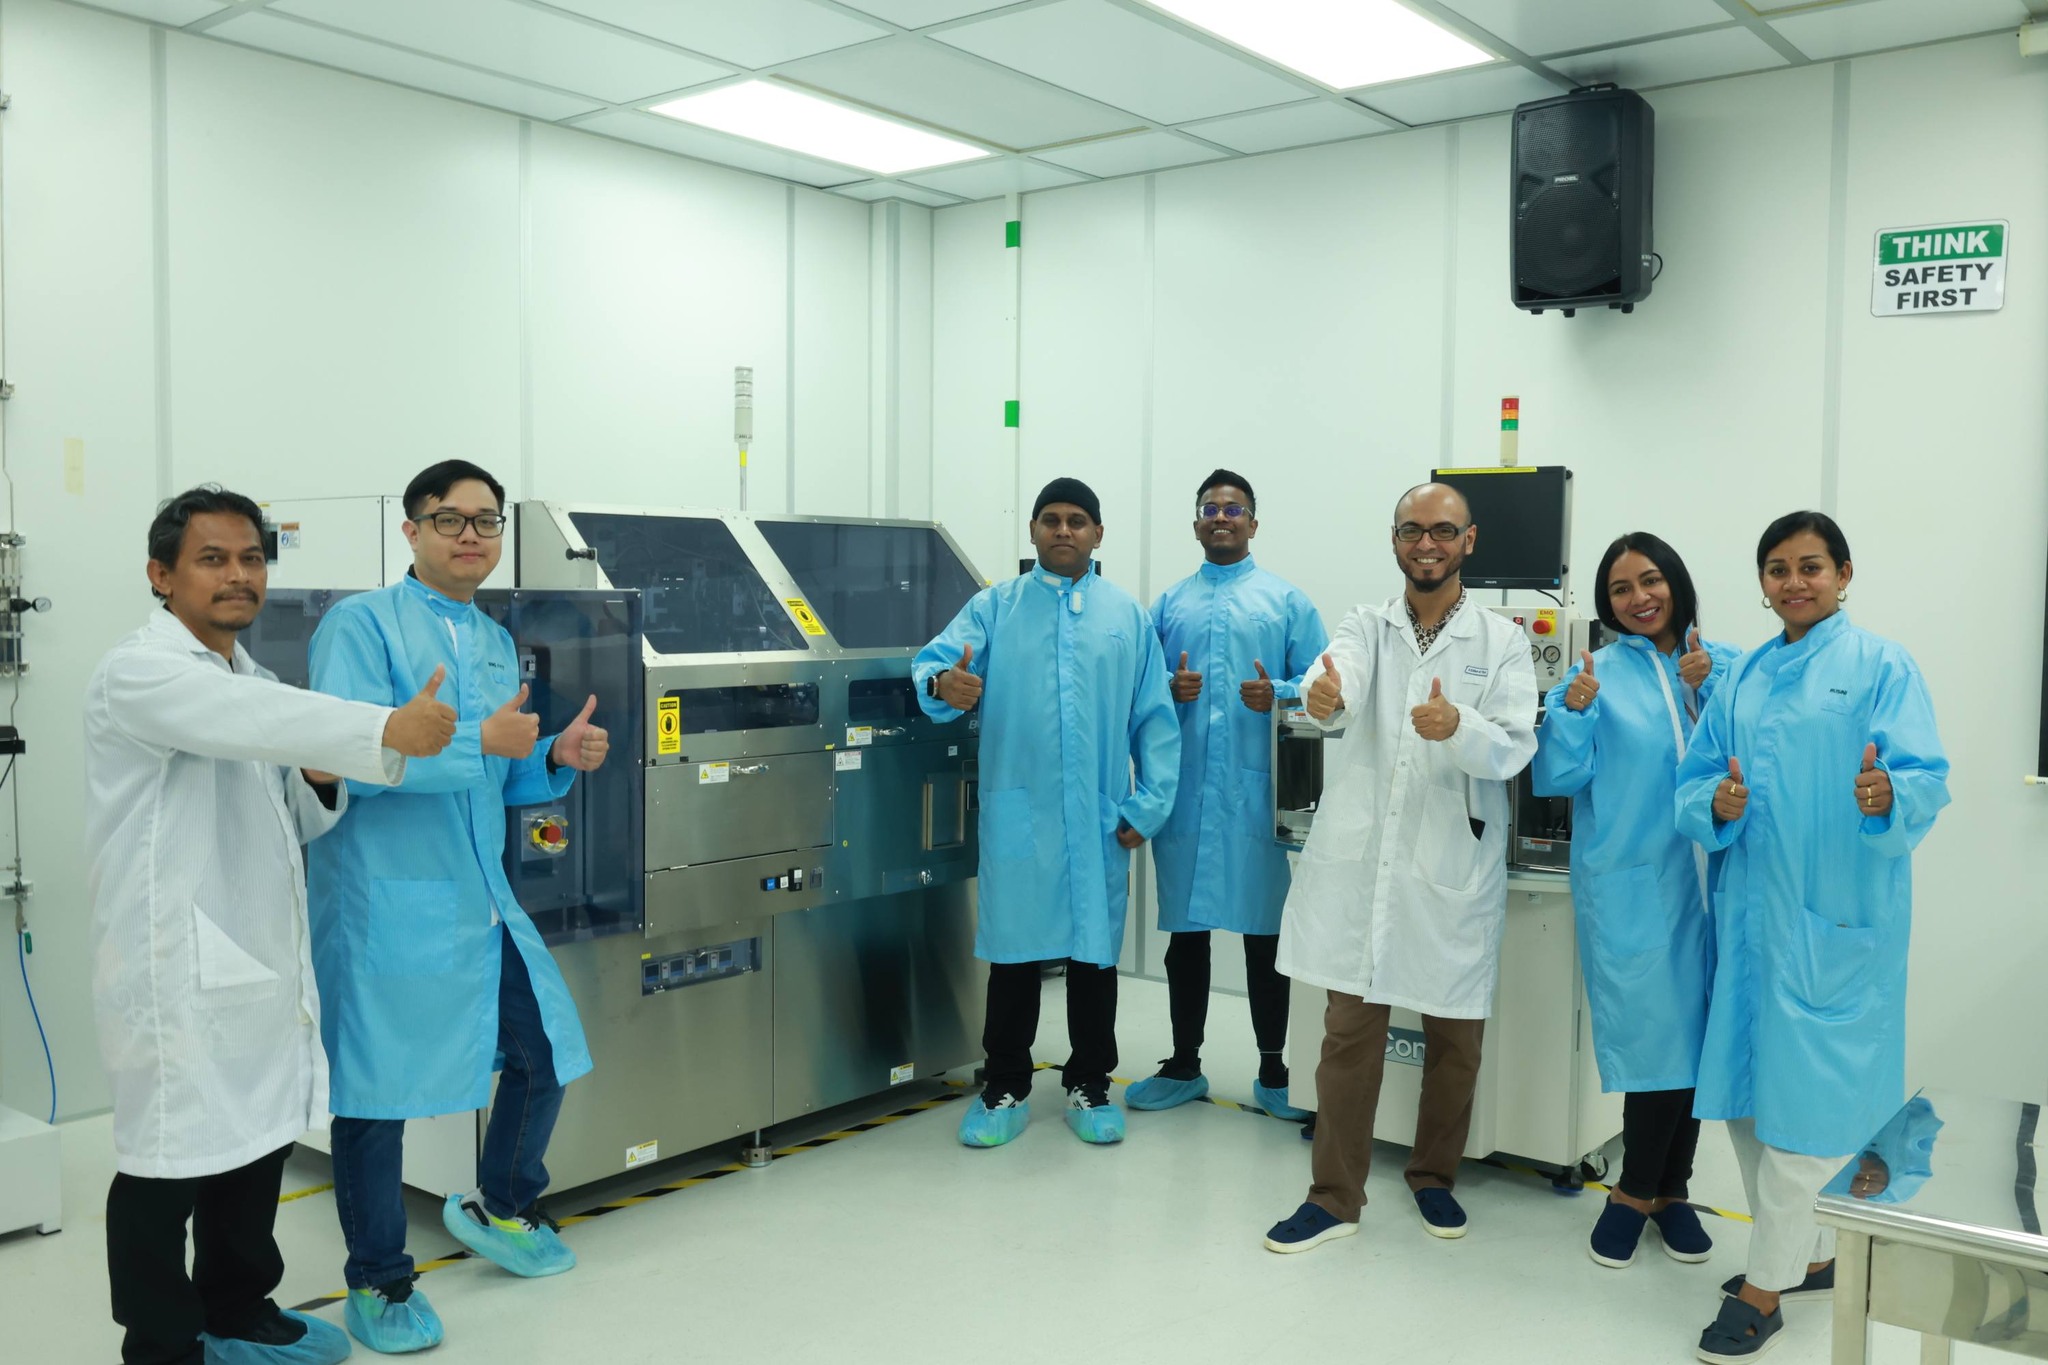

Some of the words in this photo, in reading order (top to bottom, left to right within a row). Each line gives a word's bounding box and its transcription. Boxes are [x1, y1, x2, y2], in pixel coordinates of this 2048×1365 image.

[1892, 230, 1990, 259] THINK
[1884, 262, 1994, 287] SAFETY
[1896, 287, 1978, 310] FIRST
